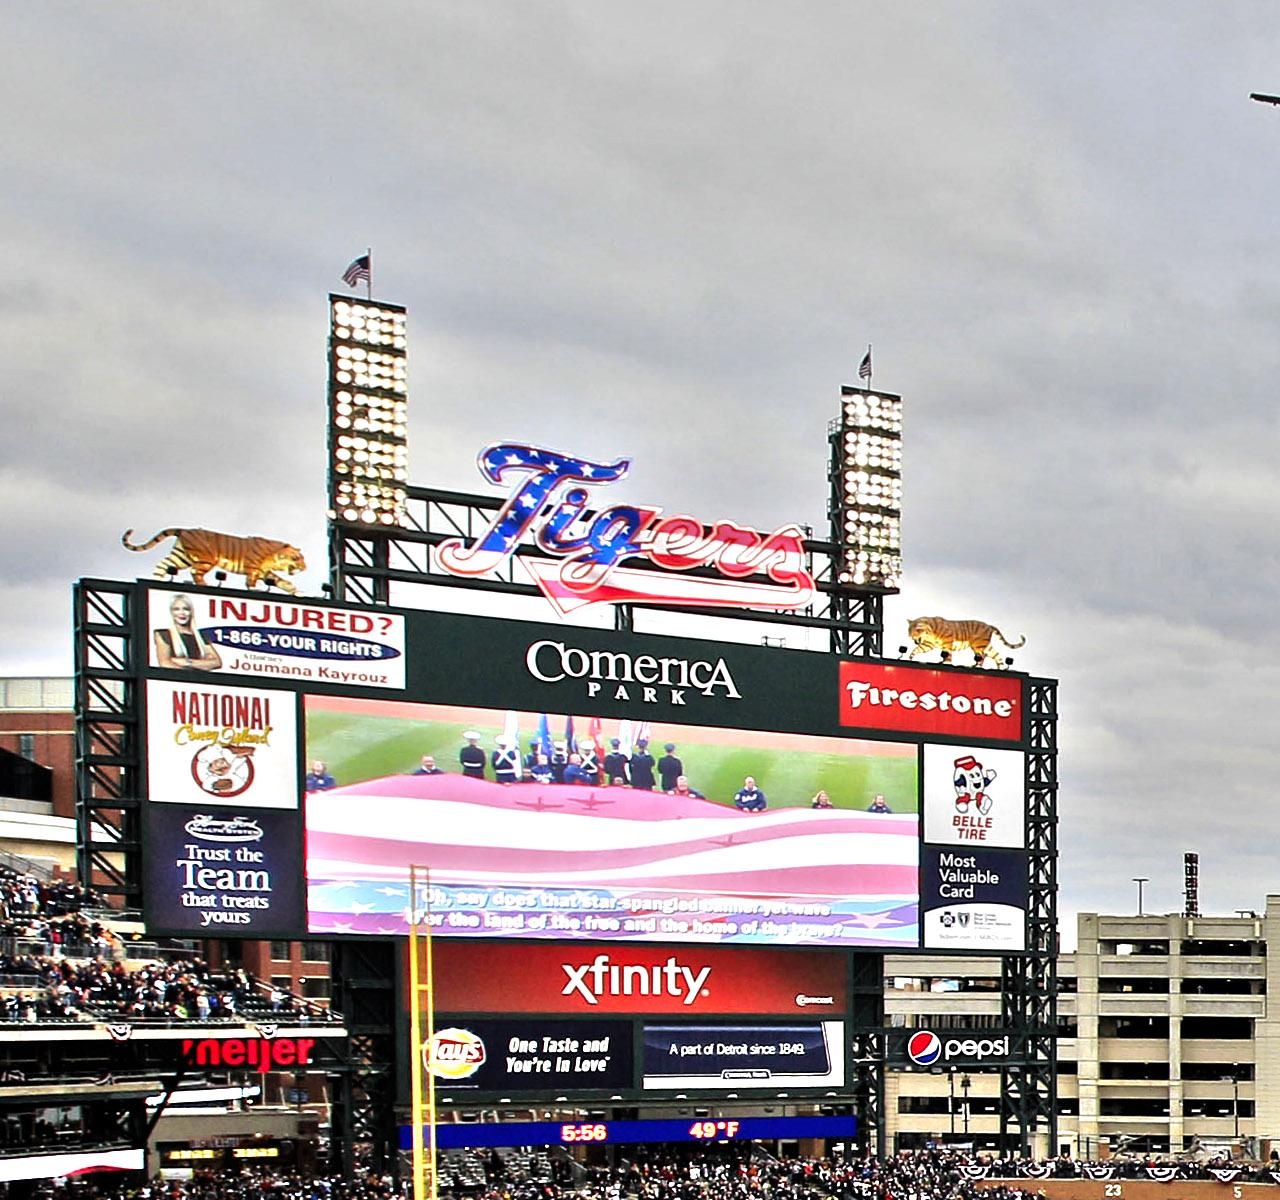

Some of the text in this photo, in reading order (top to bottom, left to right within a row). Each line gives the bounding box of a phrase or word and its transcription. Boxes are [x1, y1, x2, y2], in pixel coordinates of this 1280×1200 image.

[434, 441, 817, 612] Tigers
[209, 599, 393, 635] INJURED?
[214, 629, 383, 657] 1-866-YOUR RIGHTS
[230, 658, 388, 684] Joumana Kayrouz
[588, 682, 686, 705] PARK
[845, 680, 1014, 718] Firestone
[172, 690, 273, 731] NATIONAL
[952, 815, 993, 829] BELLE
[957, 828, 987, 841] TIRE
[184, 844, 264, 863] Trust the
[939, 853, 976, 868] Most
[176, 859, 273, 892] Team
[939, 868, 1000, 884] Valuable
[939, 882, 975, 899] Card
[182, 891, 270, 909] that treats
[492, 890, 540, 909] does
[541, 892, 579, 910] that
[200, 910, 251, 926] yours
[449, 911, 481, 928] the
[527, 913, 548, 929] of
[623, 915, 657, 932] and
[660, 917, 689, 934] the
[692, 918, 738, 935] home
[562, 955, 712, 1005] xfinity
[508, 1036, 610, 1054] One Taste and
[669, 1043, 776, 1058] A part of Detroit since
[944, 1035, 1010, 1061] pepsi
[505, 1056, 608, 1073] You're In Love
[561, 1124, 607, 1142] 5:56
[1104, 1184, 1122, 1197] 23
[1233, 1186, 1242, 1199] 5
